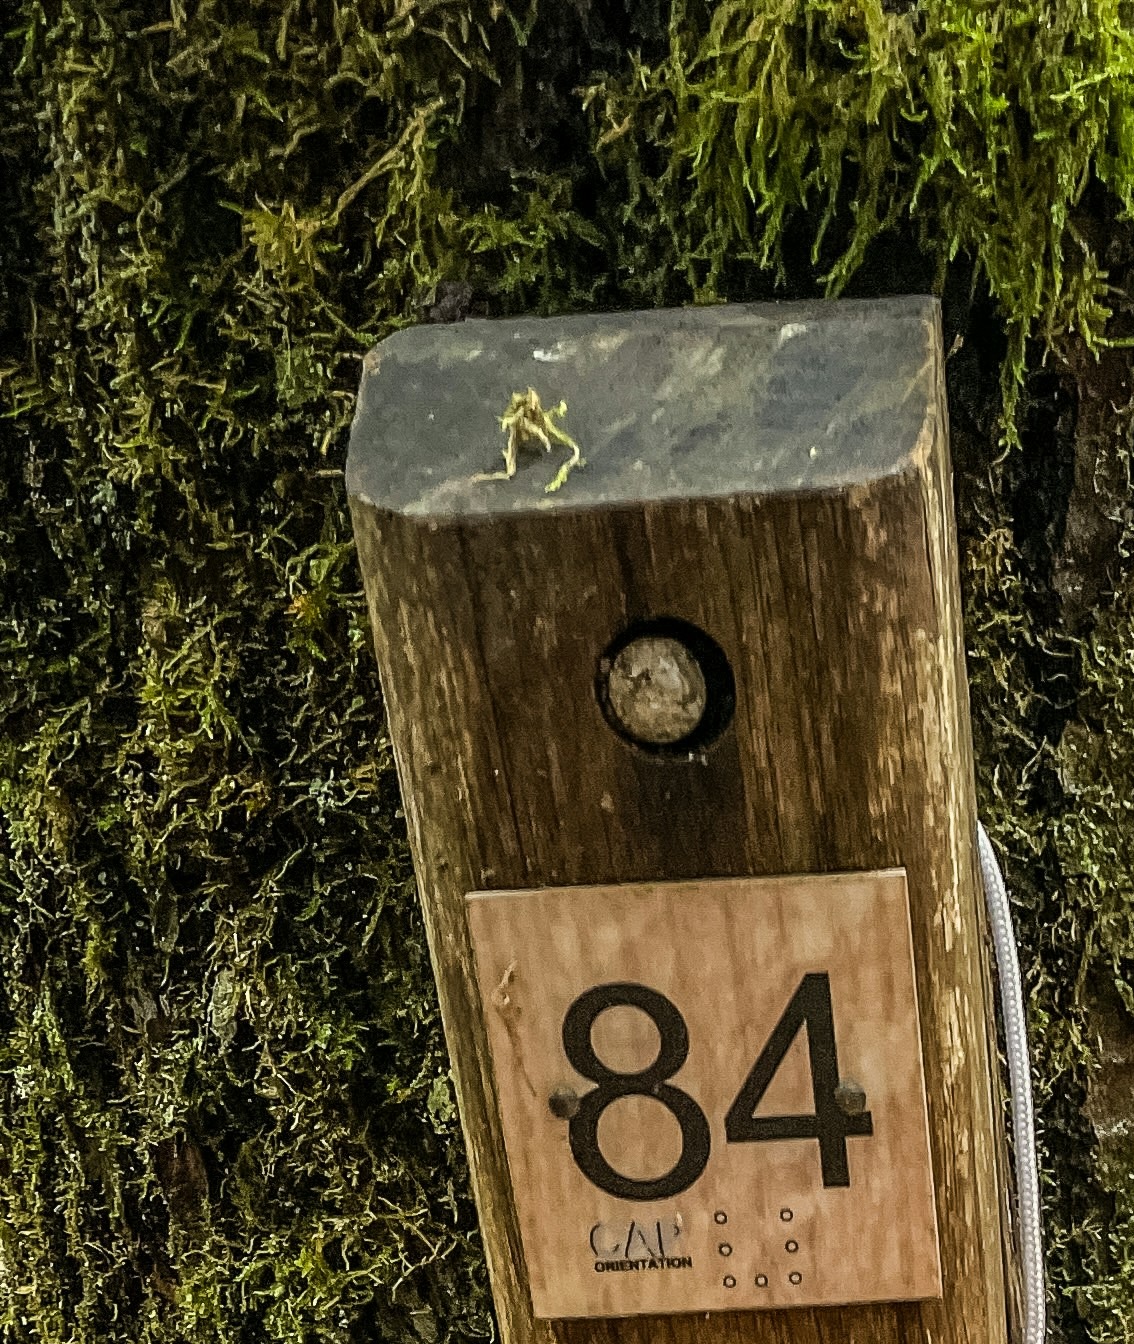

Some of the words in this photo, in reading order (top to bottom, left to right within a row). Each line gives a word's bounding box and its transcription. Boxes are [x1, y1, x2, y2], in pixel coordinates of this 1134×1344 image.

[562, 970, 874, 1202] 84
[589, 1216, 681, 1259] CAP
[594, 1256, 693, 1273] ORIENTATION
